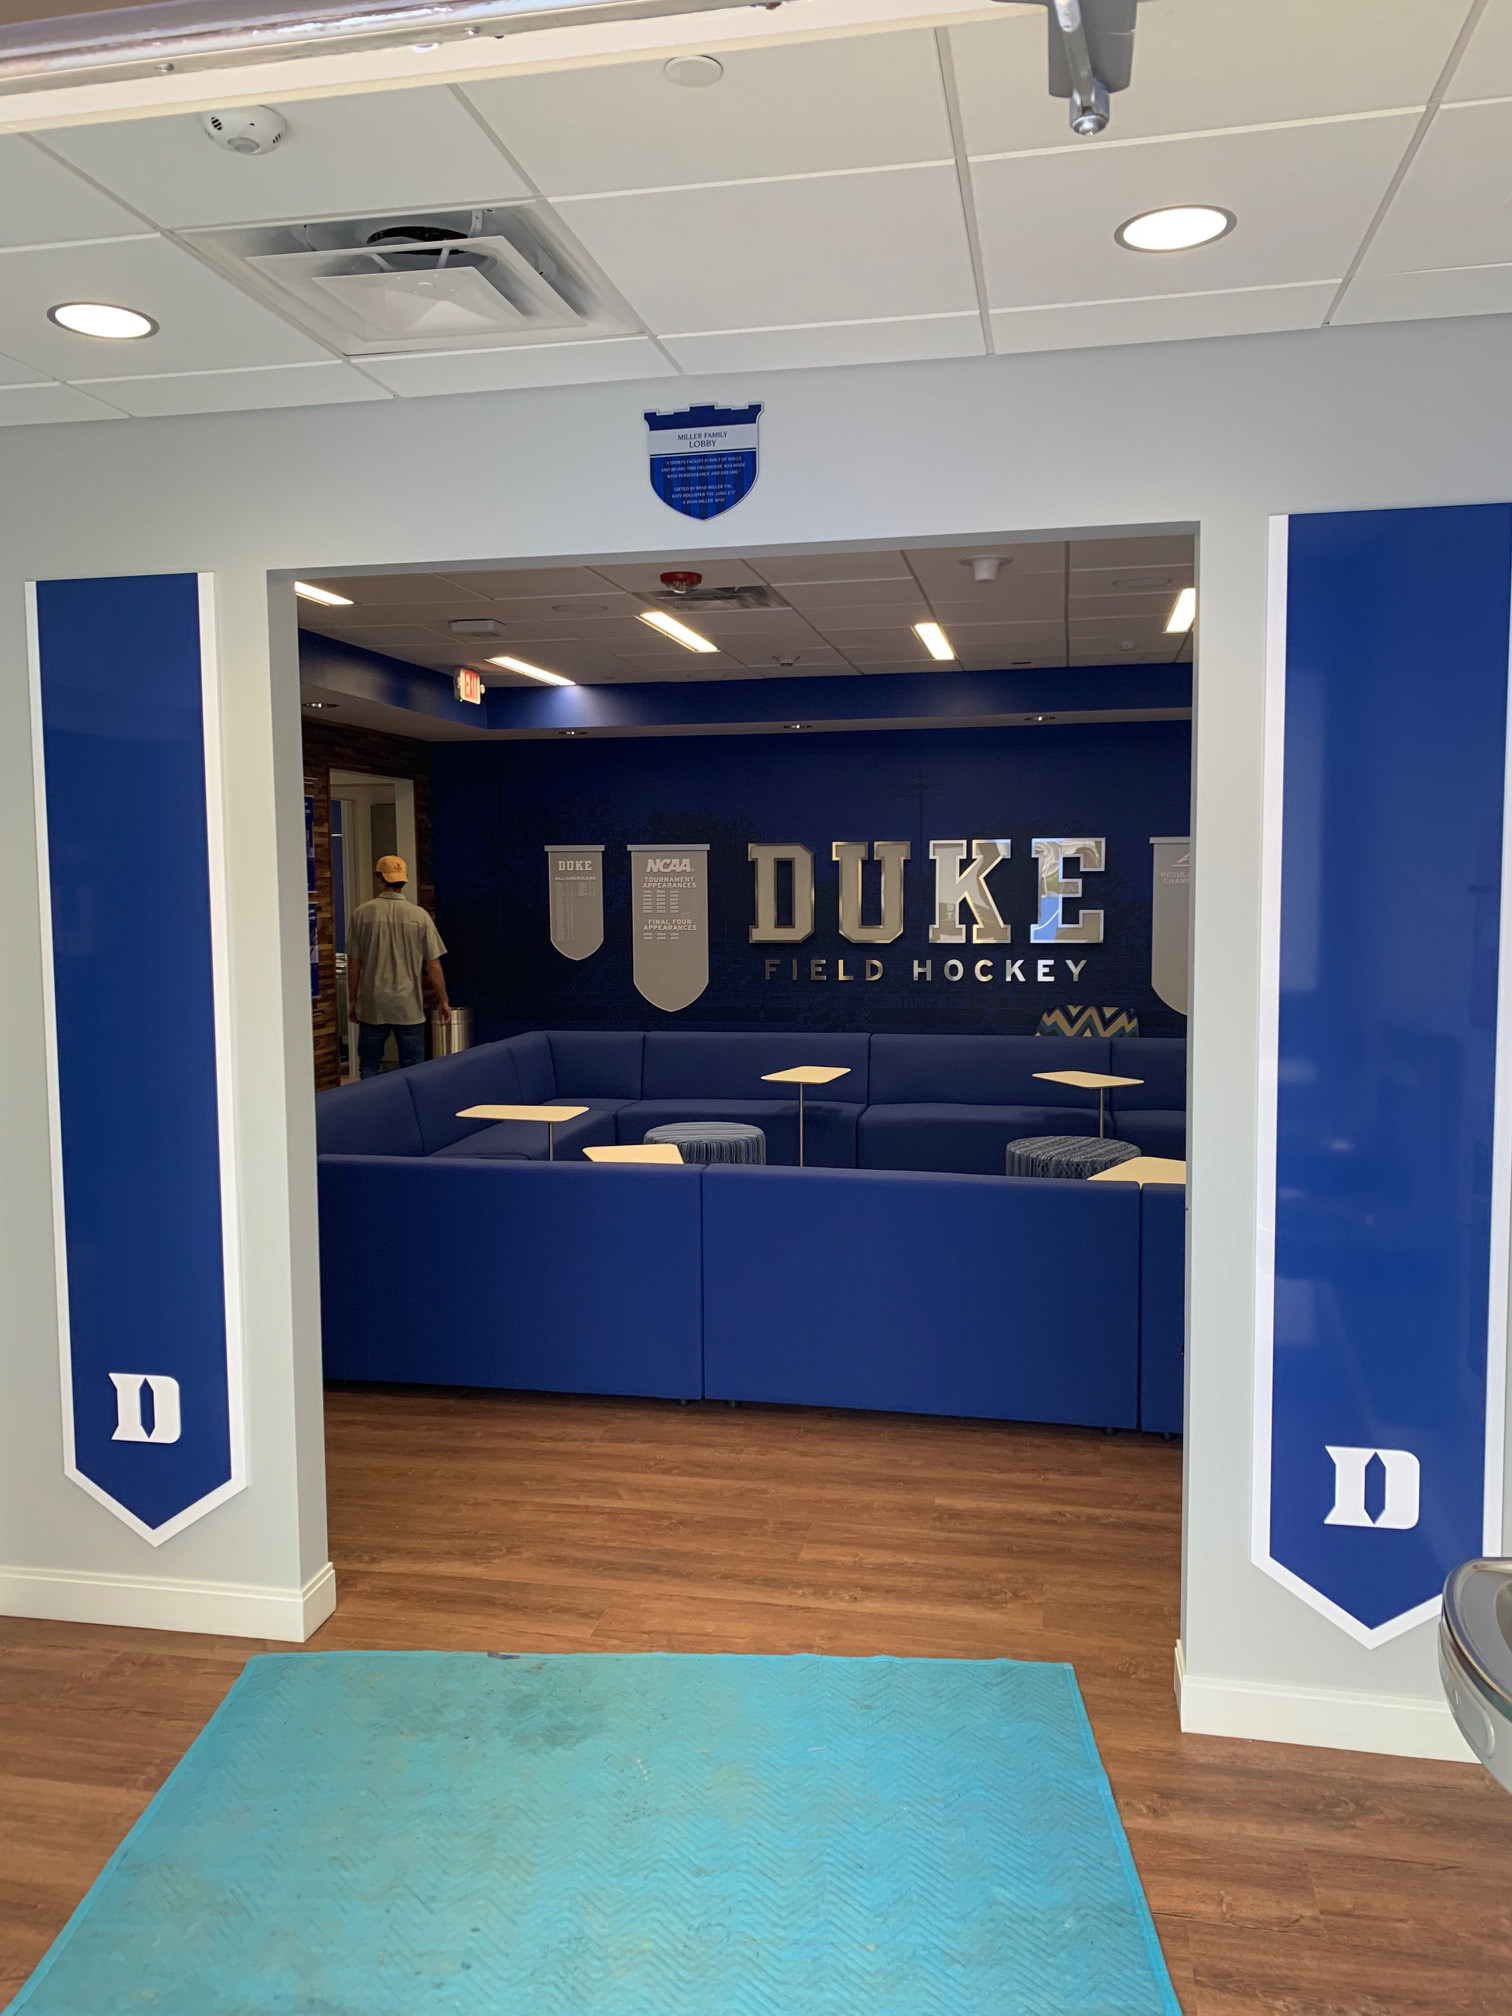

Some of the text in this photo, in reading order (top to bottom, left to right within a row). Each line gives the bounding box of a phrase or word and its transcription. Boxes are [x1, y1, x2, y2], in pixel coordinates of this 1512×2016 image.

[677, 431, 728, 441] MILLER FAMILY
[689, 440, 717, 448] LOBBY
[464, 670, 479, 701] EXIT
[558, 861, 592, 870] DUKE
[646, 859, 691, 873] NCAA
[748, 838, 1105, 943] DUKE
[765, 959, 1087, 983] FIELD HOCKEY
[108, 1372, 182, 1444] D
[1323, 1445, 1420, 1530] D
